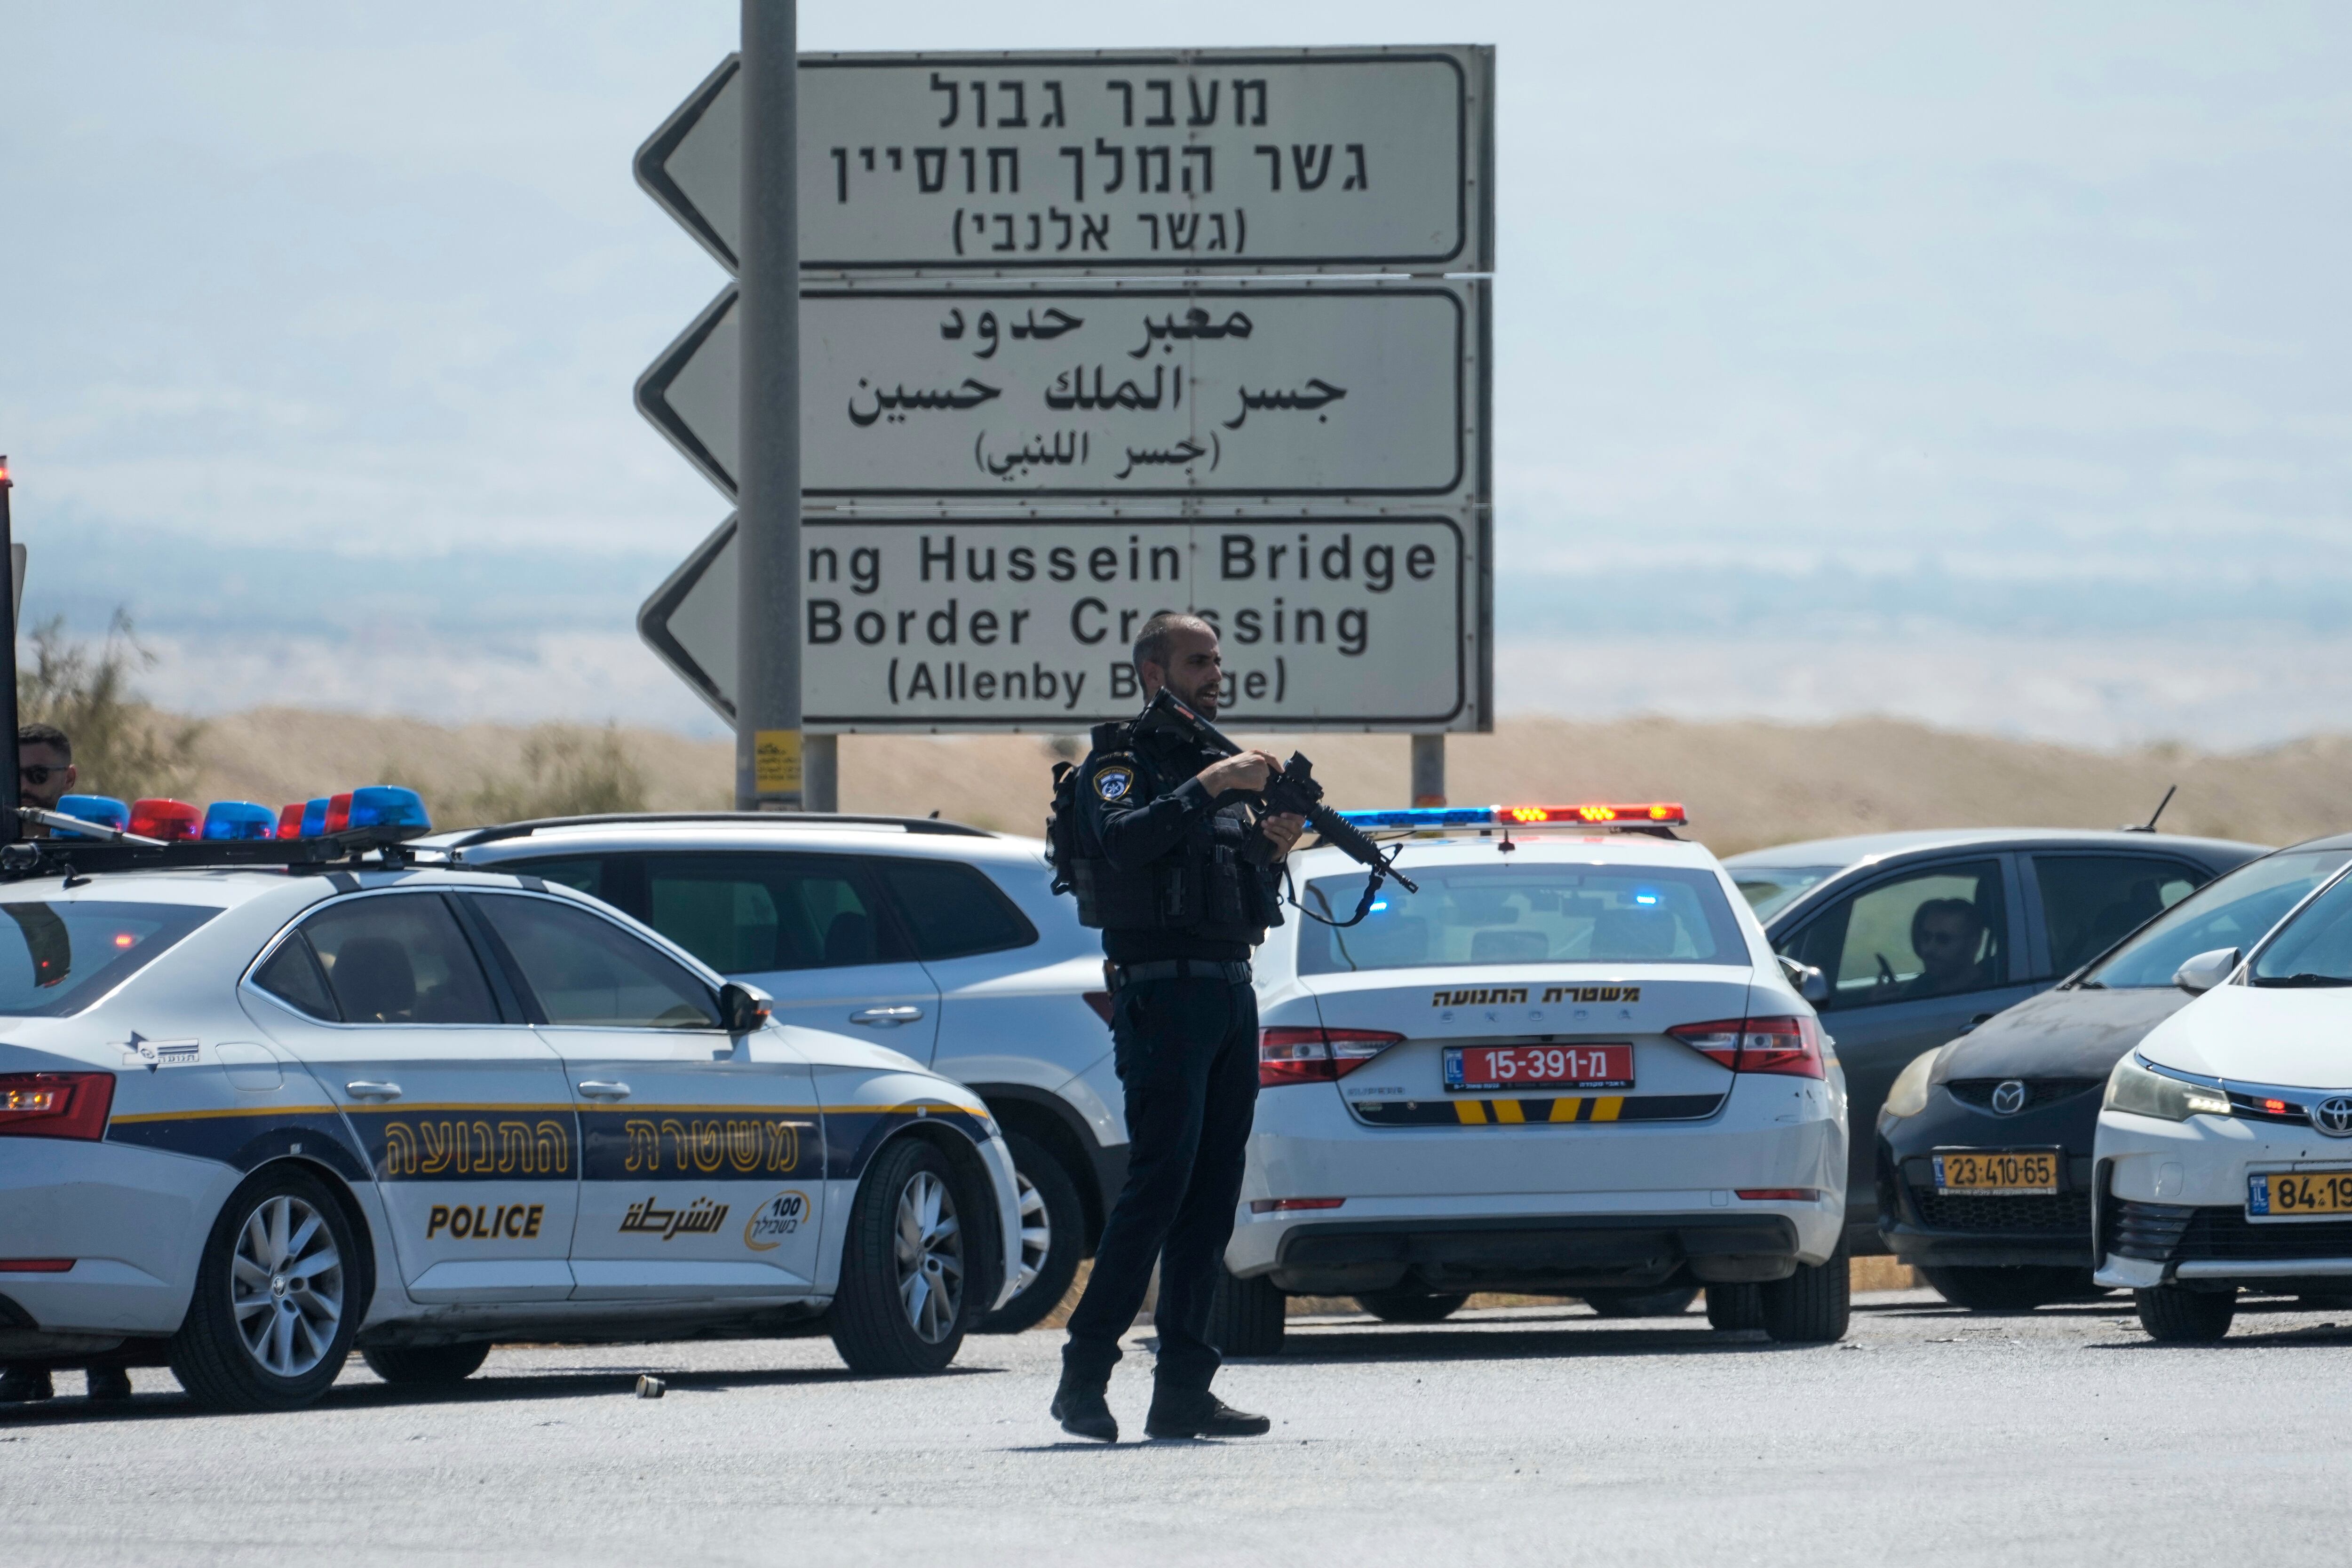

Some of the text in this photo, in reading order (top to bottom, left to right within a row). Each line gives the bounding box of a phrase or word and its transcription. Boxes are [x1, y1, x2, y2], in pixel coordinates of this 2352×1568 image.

[930, 72, 1267, 129] מעבר גבול
[830, 137, 1368, 204] גשר המלך חוסיין
[953, 206, 1246, 256] (גשר אלנבי)
[940, 307, 1254, 360] معبر حدود
[848, 364, 1347, 430] جسر الملك حسين
[1116, 433, 1220, 480] (جسر
[809, 532, 1436, 595] ng Hussein Bridge
[807, 596, 1030, 646] Border
[888, 657, 1286, 710] (Allenby Bge)
[1432, 987, 1641, 1007] משטרת התנועה
[385, 1118, 798, 1174] משטרת התנועה
[426, 1204, 545, 1240] POLICE
[618, 1196, 731, 1242] الشرطة
[752, 1215, 798, 1239] בשבילך
[771, 1196, 802, 1217] 100
